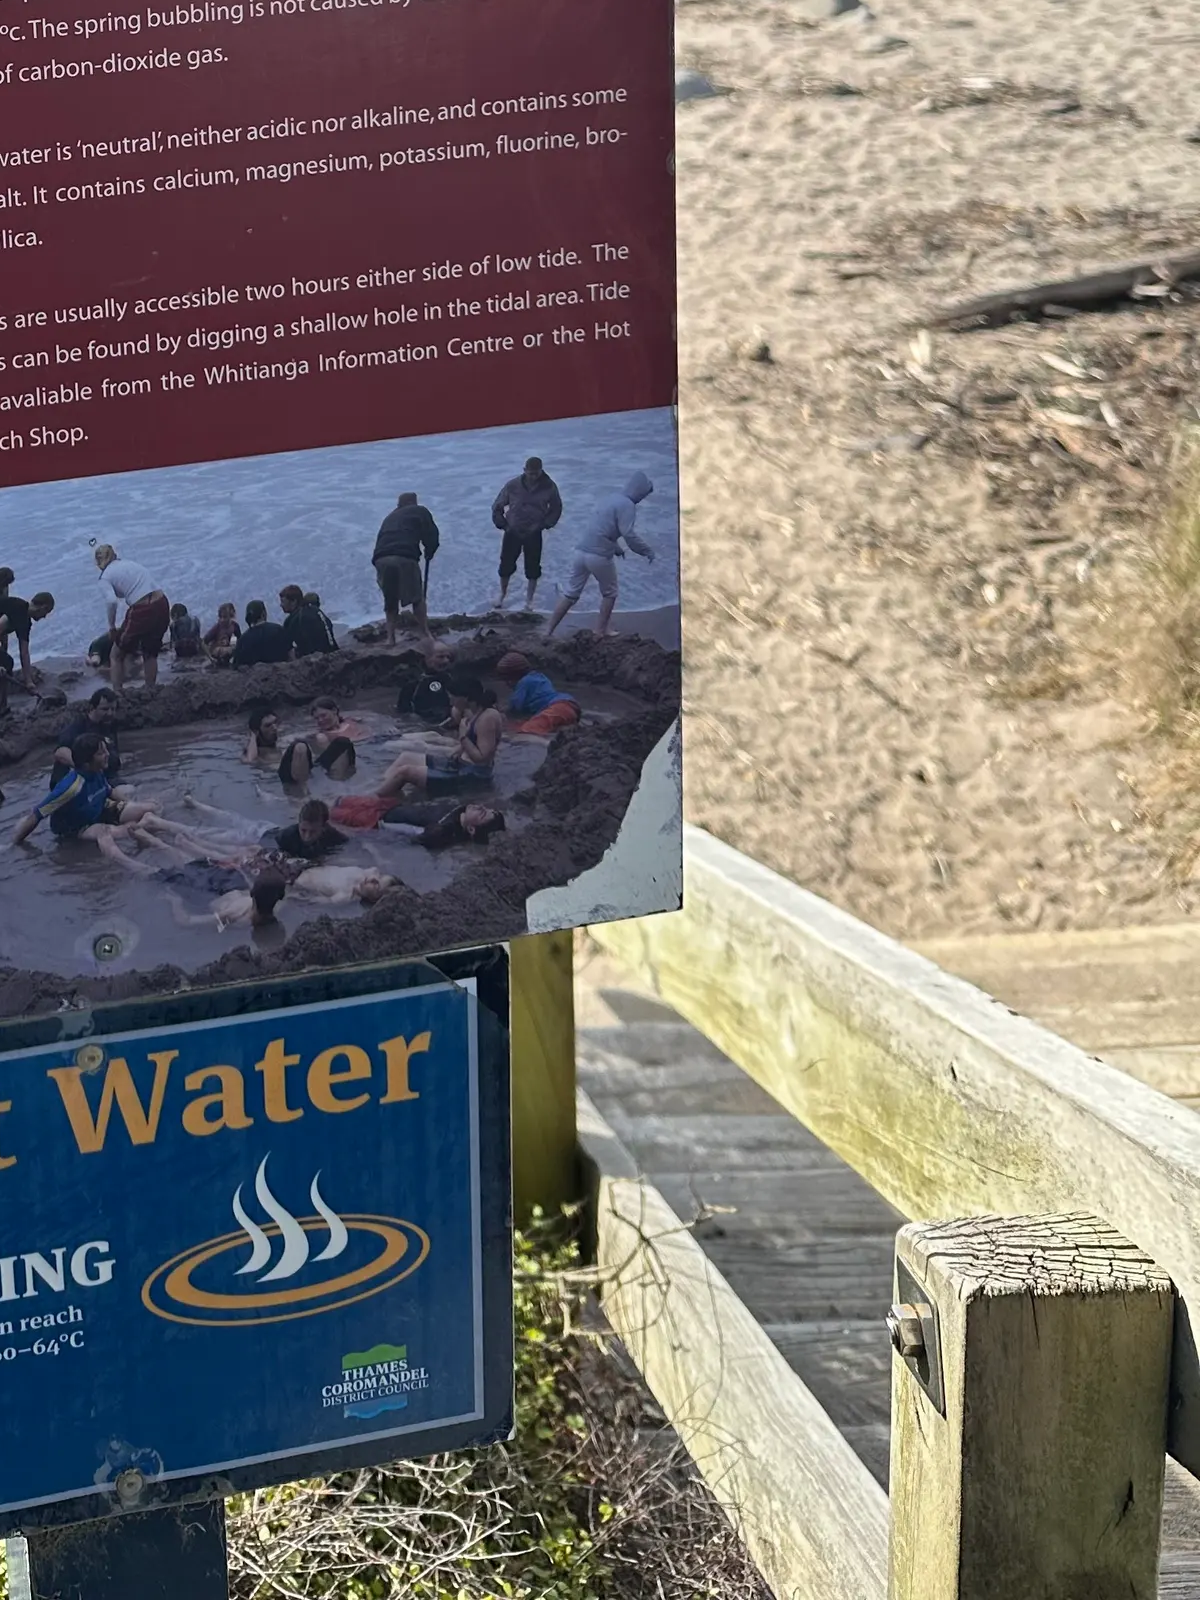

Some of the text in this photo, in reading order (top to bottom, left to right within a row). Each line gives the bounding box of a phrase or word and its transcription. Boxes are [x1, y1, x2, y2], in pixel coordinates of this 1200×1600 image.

[29, 425, 88, 446] Shop.
[46, 1029, 433, 1155] Water
[19, 1304, 83, 1332] reach
[321, 1367, 429, 1398] COROMANDEL
[341, 1358, 408, 1382] THAMES
[322, 1378, 430, 1408] DISTRICT COUNCIL
